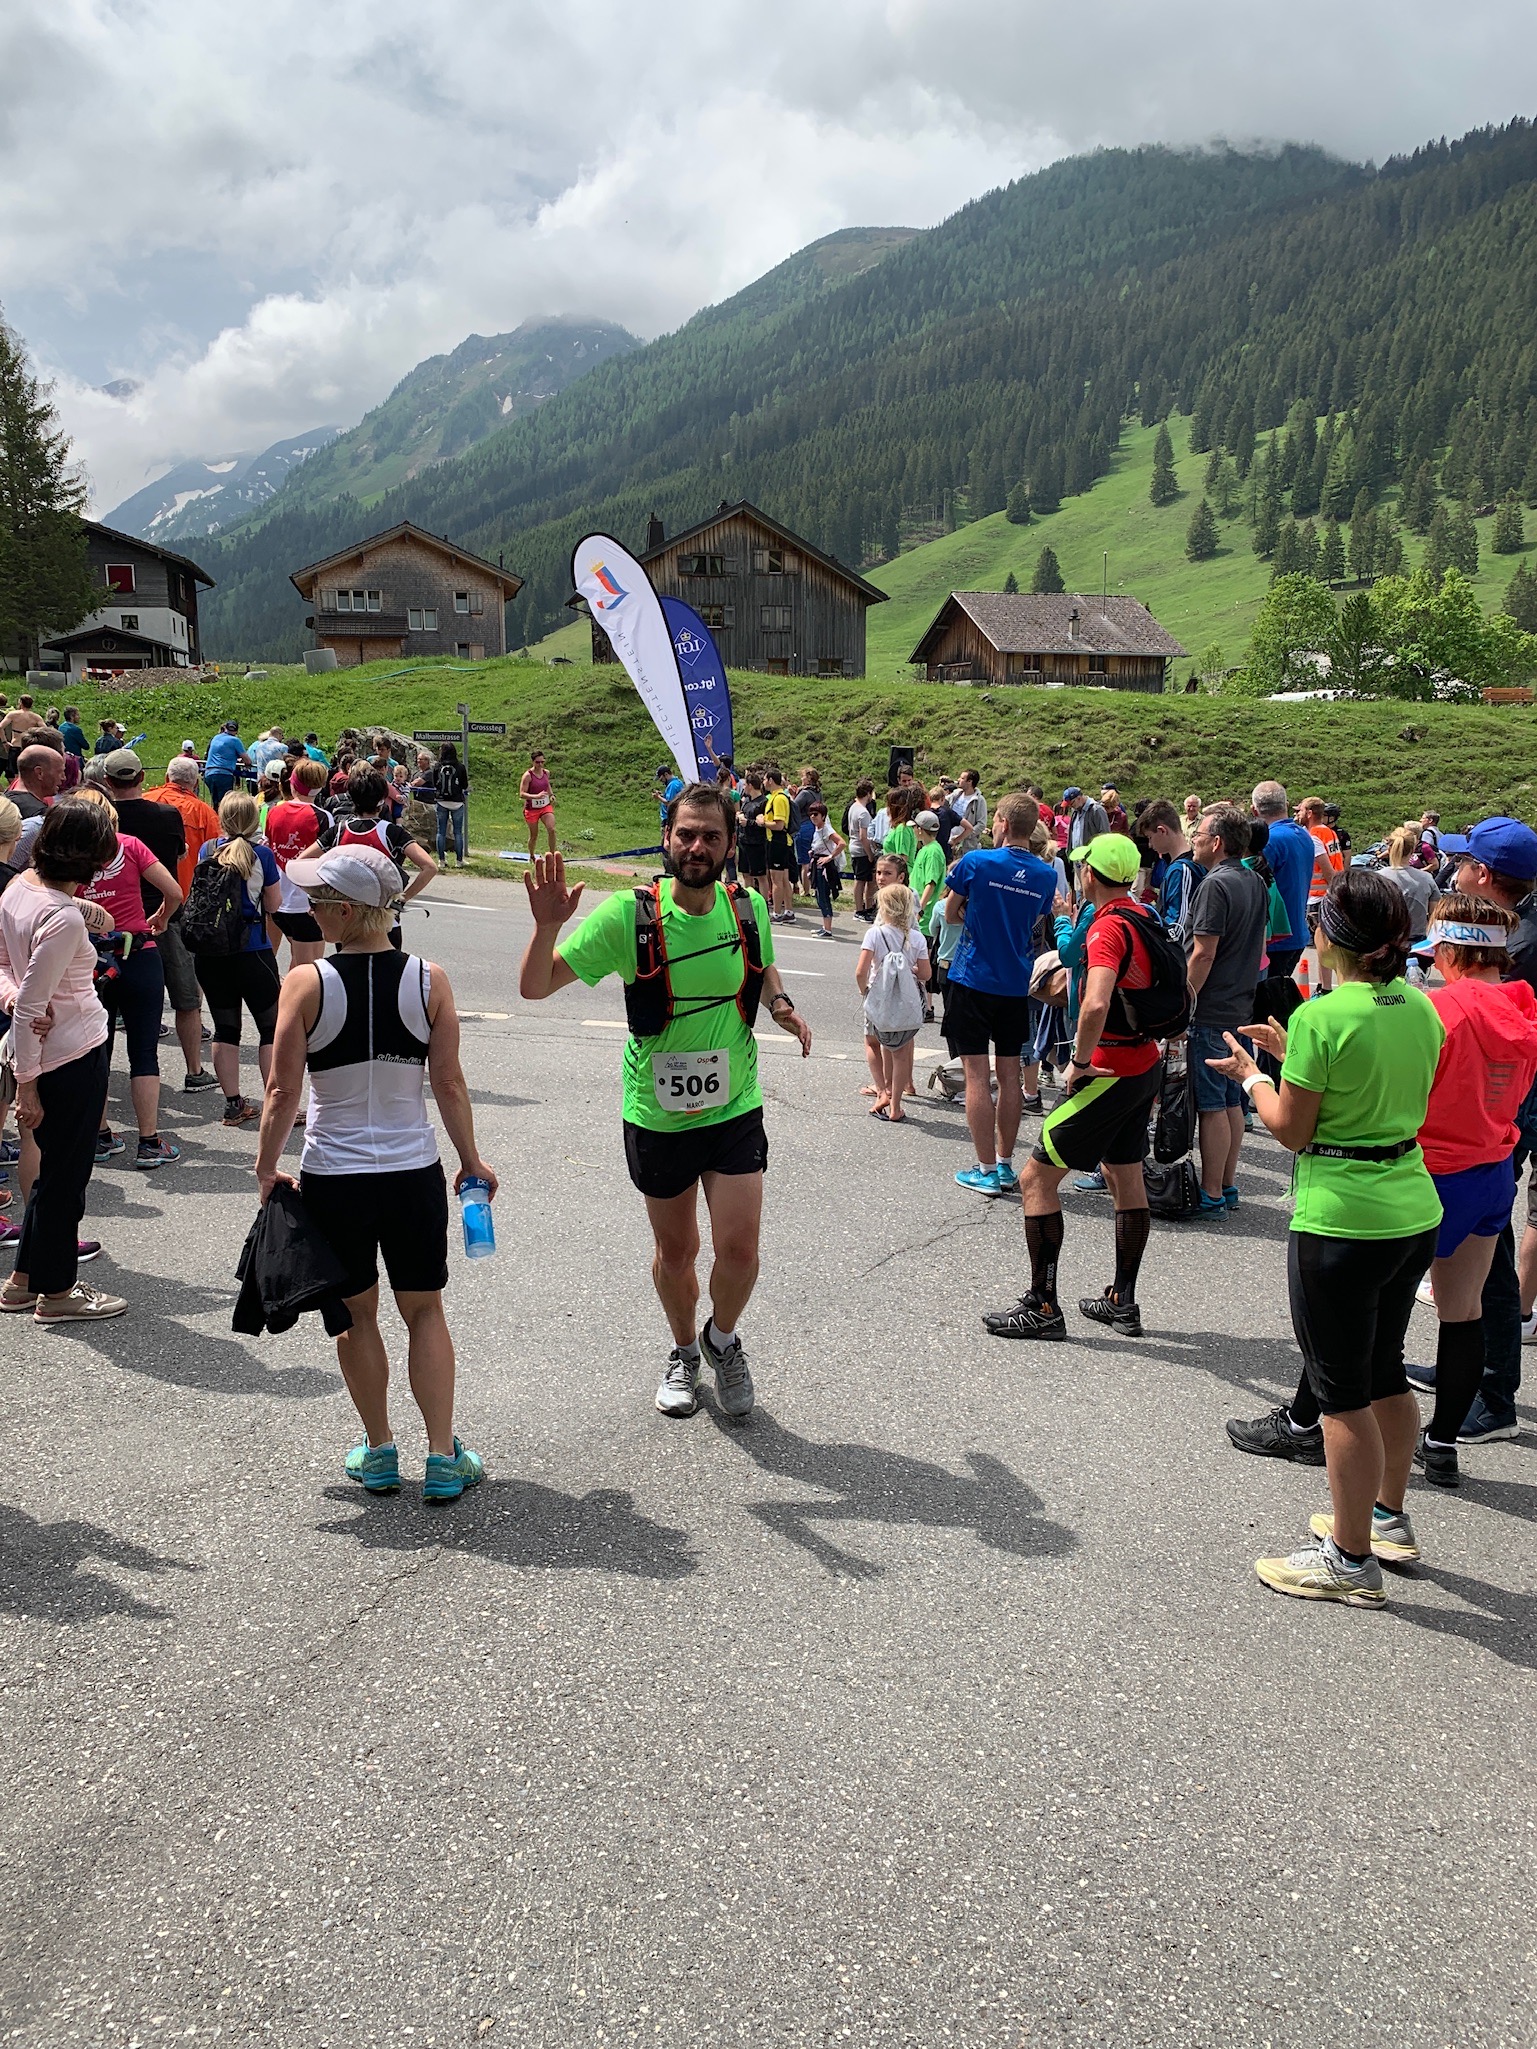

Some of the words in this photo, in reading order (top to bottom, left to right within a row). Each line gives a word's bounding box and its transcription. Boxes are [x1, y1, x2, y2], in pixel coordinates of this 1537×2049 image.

[471, 724, 503, 734] Grosssteg
[415, 733, 460, 741] Malbunstrasse
[84, 890, 116, 900] warrior
[1372, 994, 1406, 1006] MIZUNO
[670, 1072, 720, 1097] 506
[686, 1100, 704, 1109] MARCO
